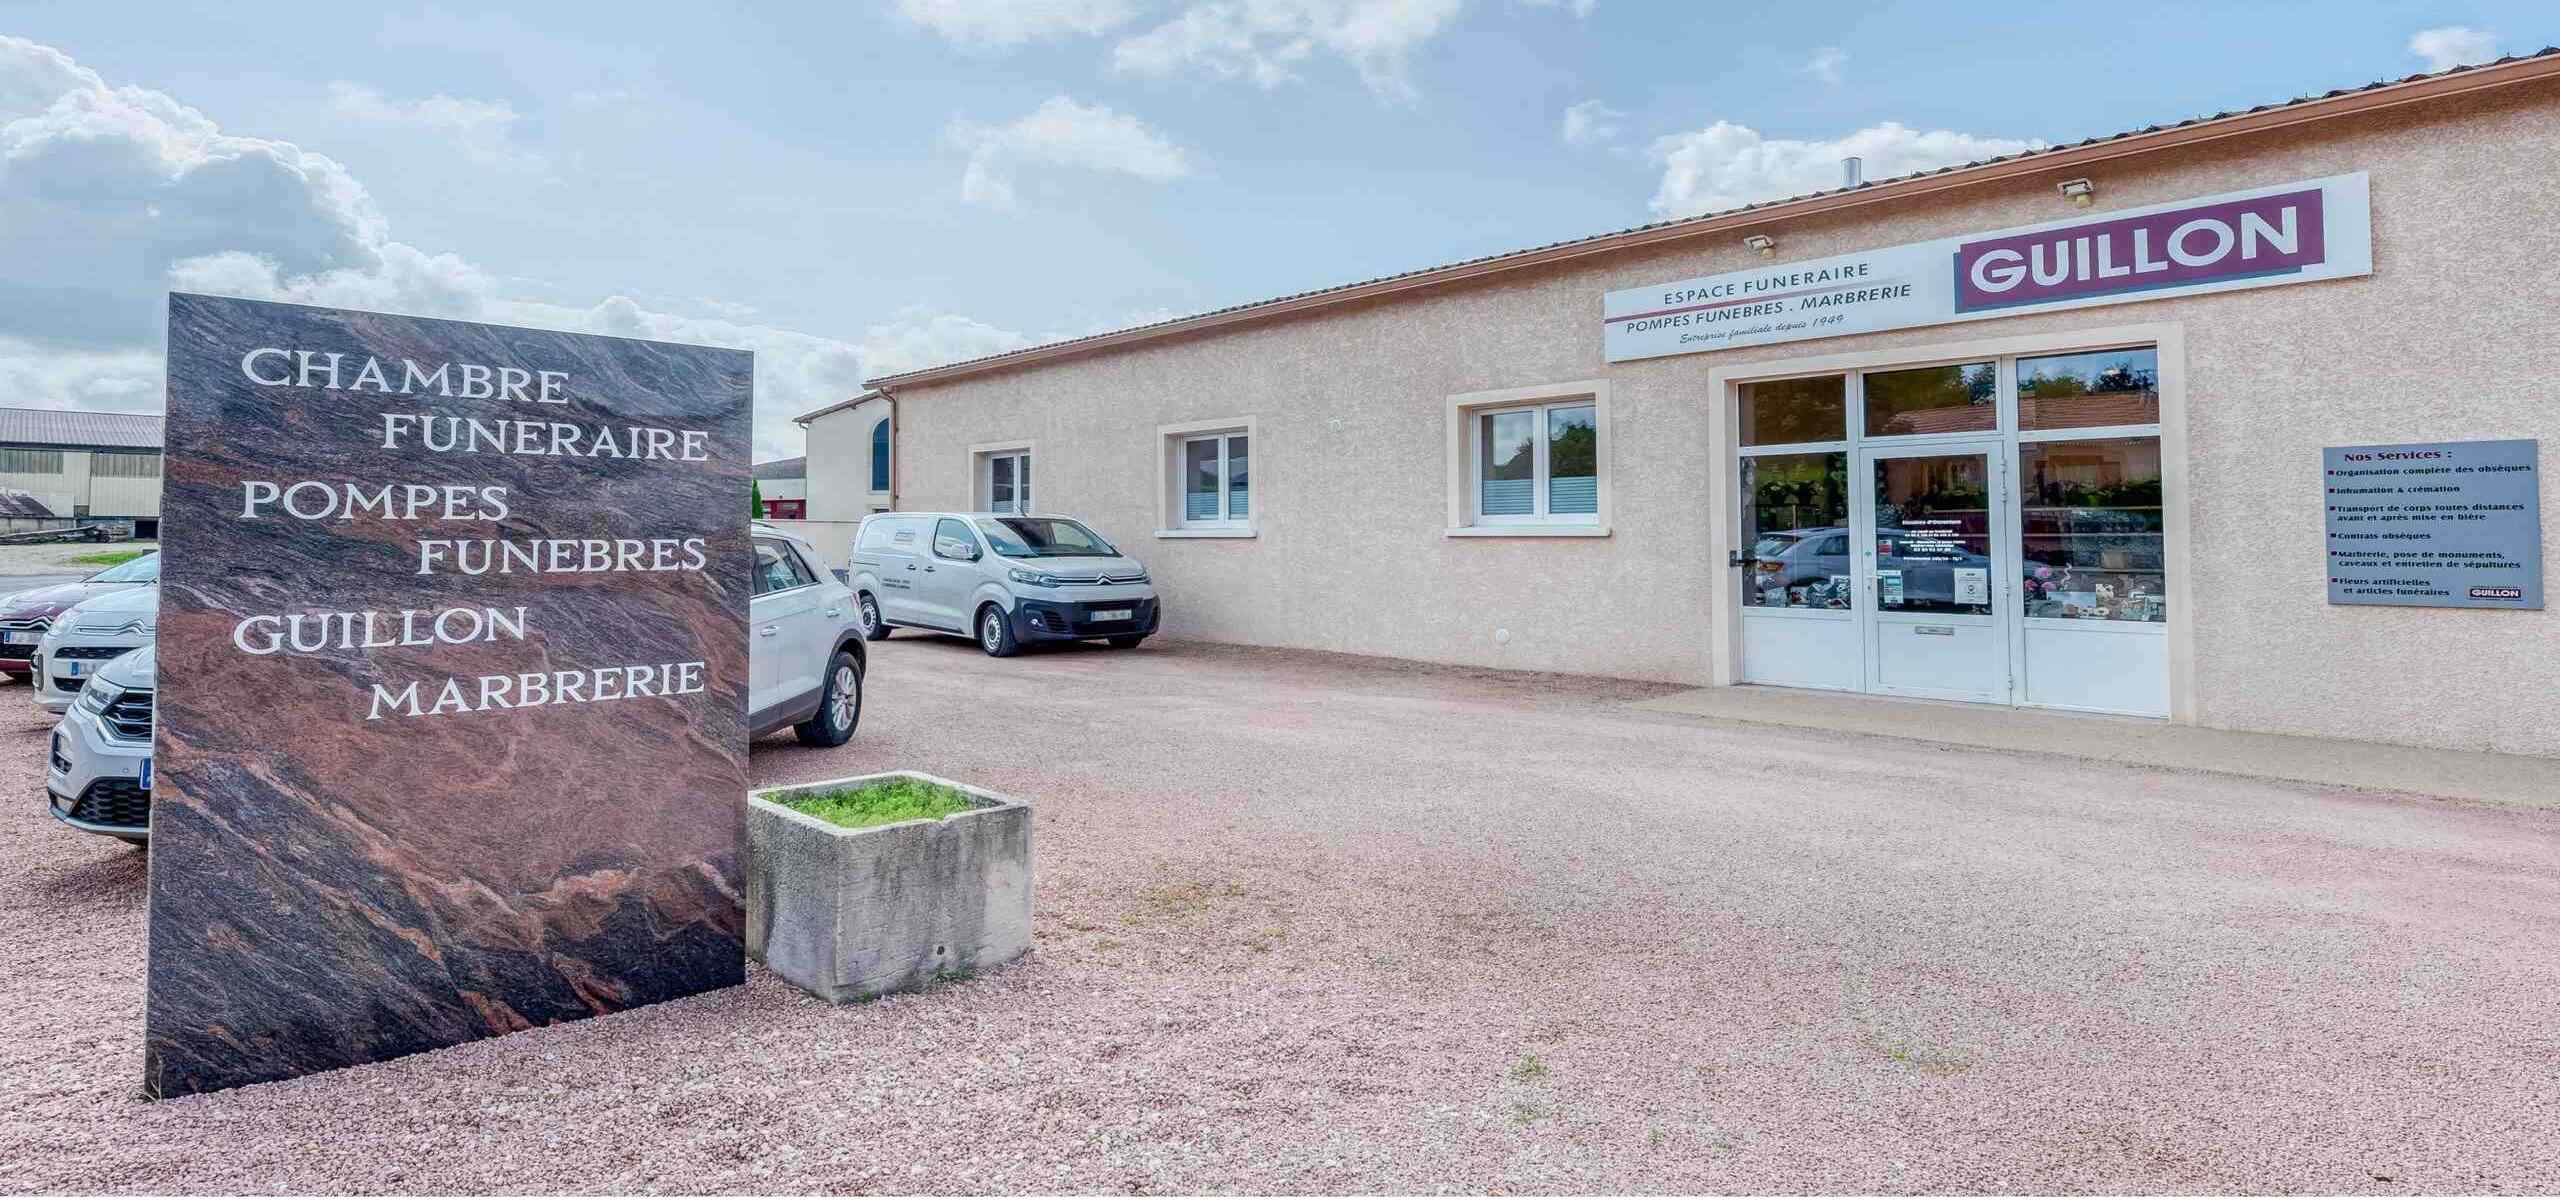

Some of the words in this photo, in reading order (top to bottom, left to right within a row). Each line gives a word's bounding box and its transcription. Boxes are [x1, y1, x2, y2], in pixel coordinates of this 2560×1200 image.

[1970, 205, 2298, 293] GUILLON
[1664, 283, 1735, 305] ESPACE
[1744, 263, 1869, 293] FUNERAIRE
[1627, 314, 1690, 334] POMPES
[1696, 301, 1783, 325] FUNEBRES
[1801, 284, 1912, 311] MARBRERIE
[1728, 324, 1772, 340] familiale
[1775, 318, 1806, 333] depuis
[242, 348, 569, 404] CHAMBRE
[381, 413, 709, 462] FUNERAIRE
[2344, 453, 2372, 461] Nos
[2377, 450, 2441, 460] Services
[2336, 468, 2399, 477] Organisation
[2456, 465, 2474, 473] des
[239, 480, 509, 521] POMPES
[2338, 505, 2384, 513] Transport
[2404, 504, 2432, 512] corps
[2472, 503, 2525, 511] distances
[2381, 513, 2408, 522] après
[417, 538, 707, 575] FUNEBRES
[2396, 560, 2443, 568] entretien
[2438, 551, 2505, 560] monuments,
[2356, 587, 2393, 595] articles
[2373, 578, 2430, 586] artificielles
[2471, 589, 2520, 597] GUILLON
[233, 606, 527, 655] GUILLON
[366, 661, 706, 720] MARBRERIE
